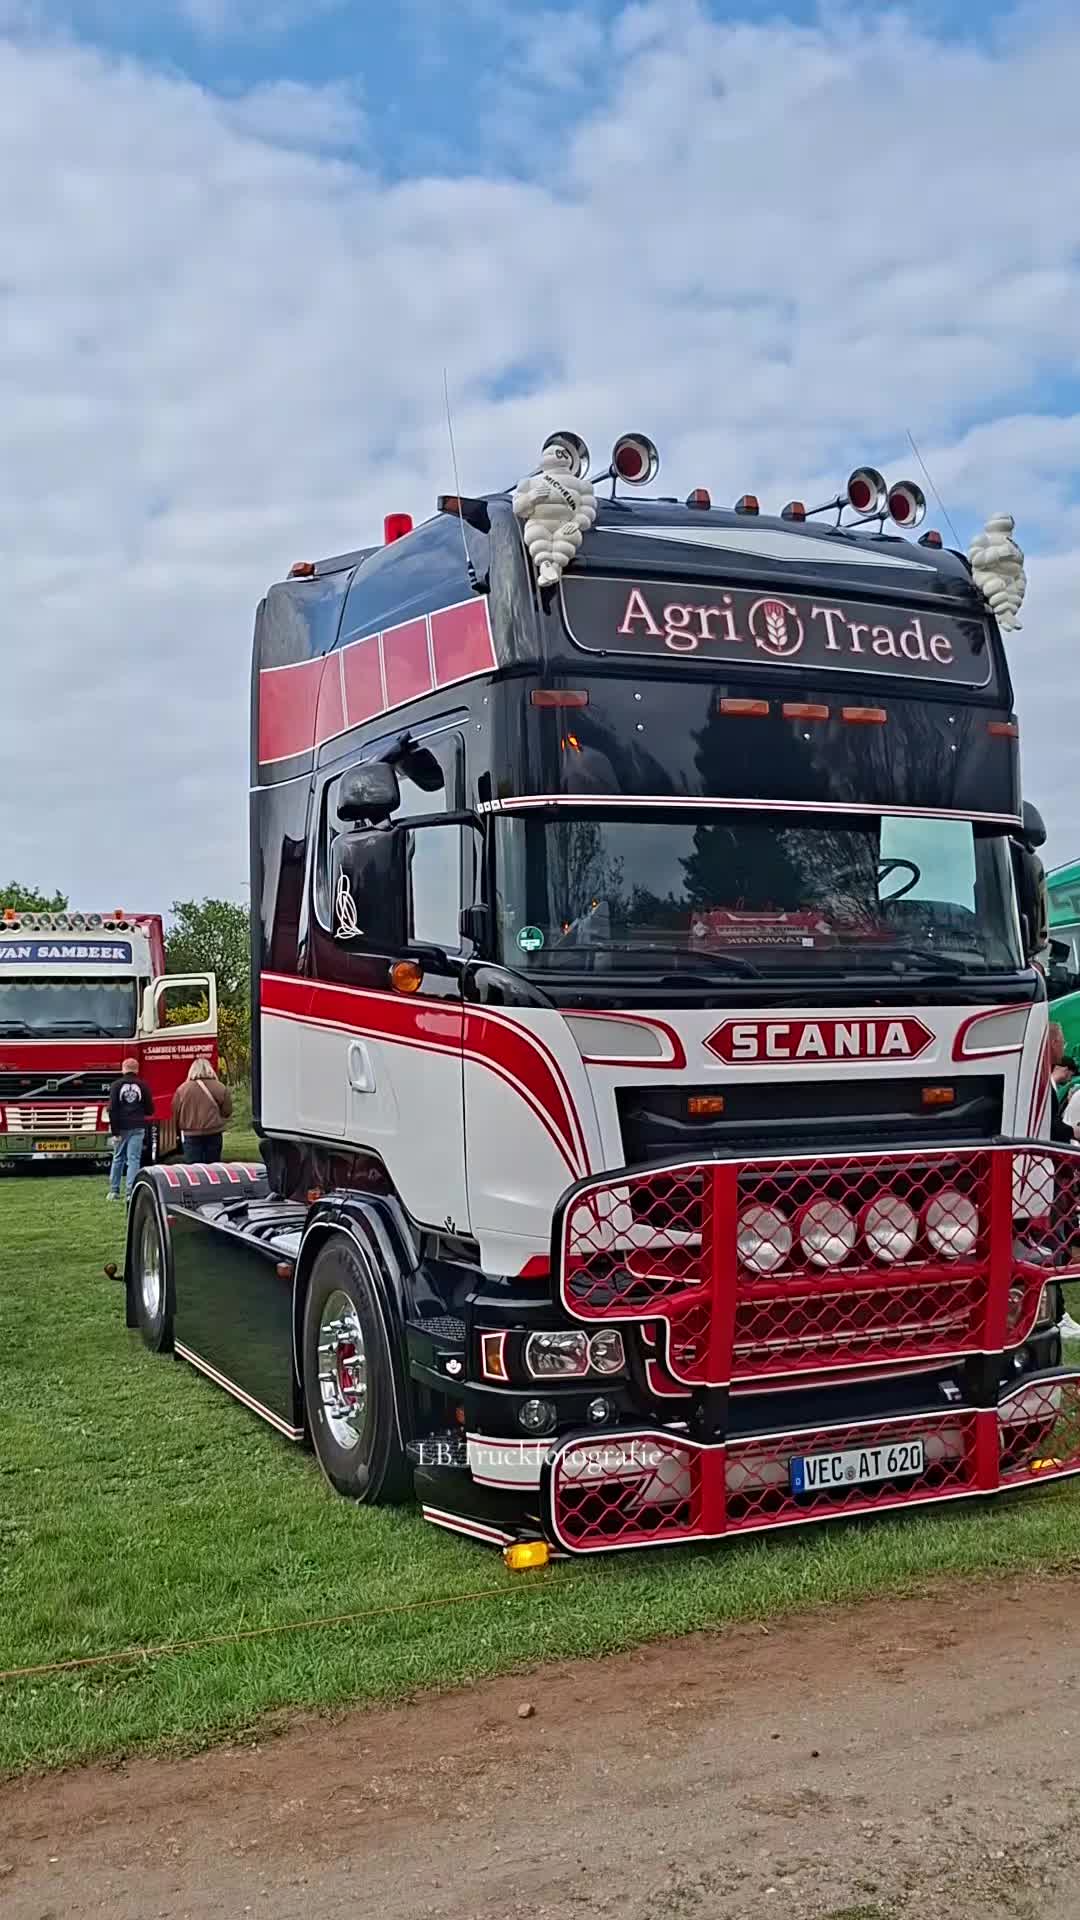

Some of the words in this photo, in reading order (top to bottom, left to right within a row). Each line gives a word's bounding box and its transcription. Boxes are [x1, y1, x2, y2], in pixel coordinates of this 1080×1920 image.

[544, 475, 576, 511] MICHELIN
[617, 588, 743, 650] Agri
[810, 604, 955, 665] Trade
[37, 946, 125, 959] SAMBEEK
[732, 1022, 912, 1058] SCANIA
[805, 1456, 843, 1485] VEC
[859, 1451, 882, 1479] AT
[887, 1445, 921, 1473] 620
